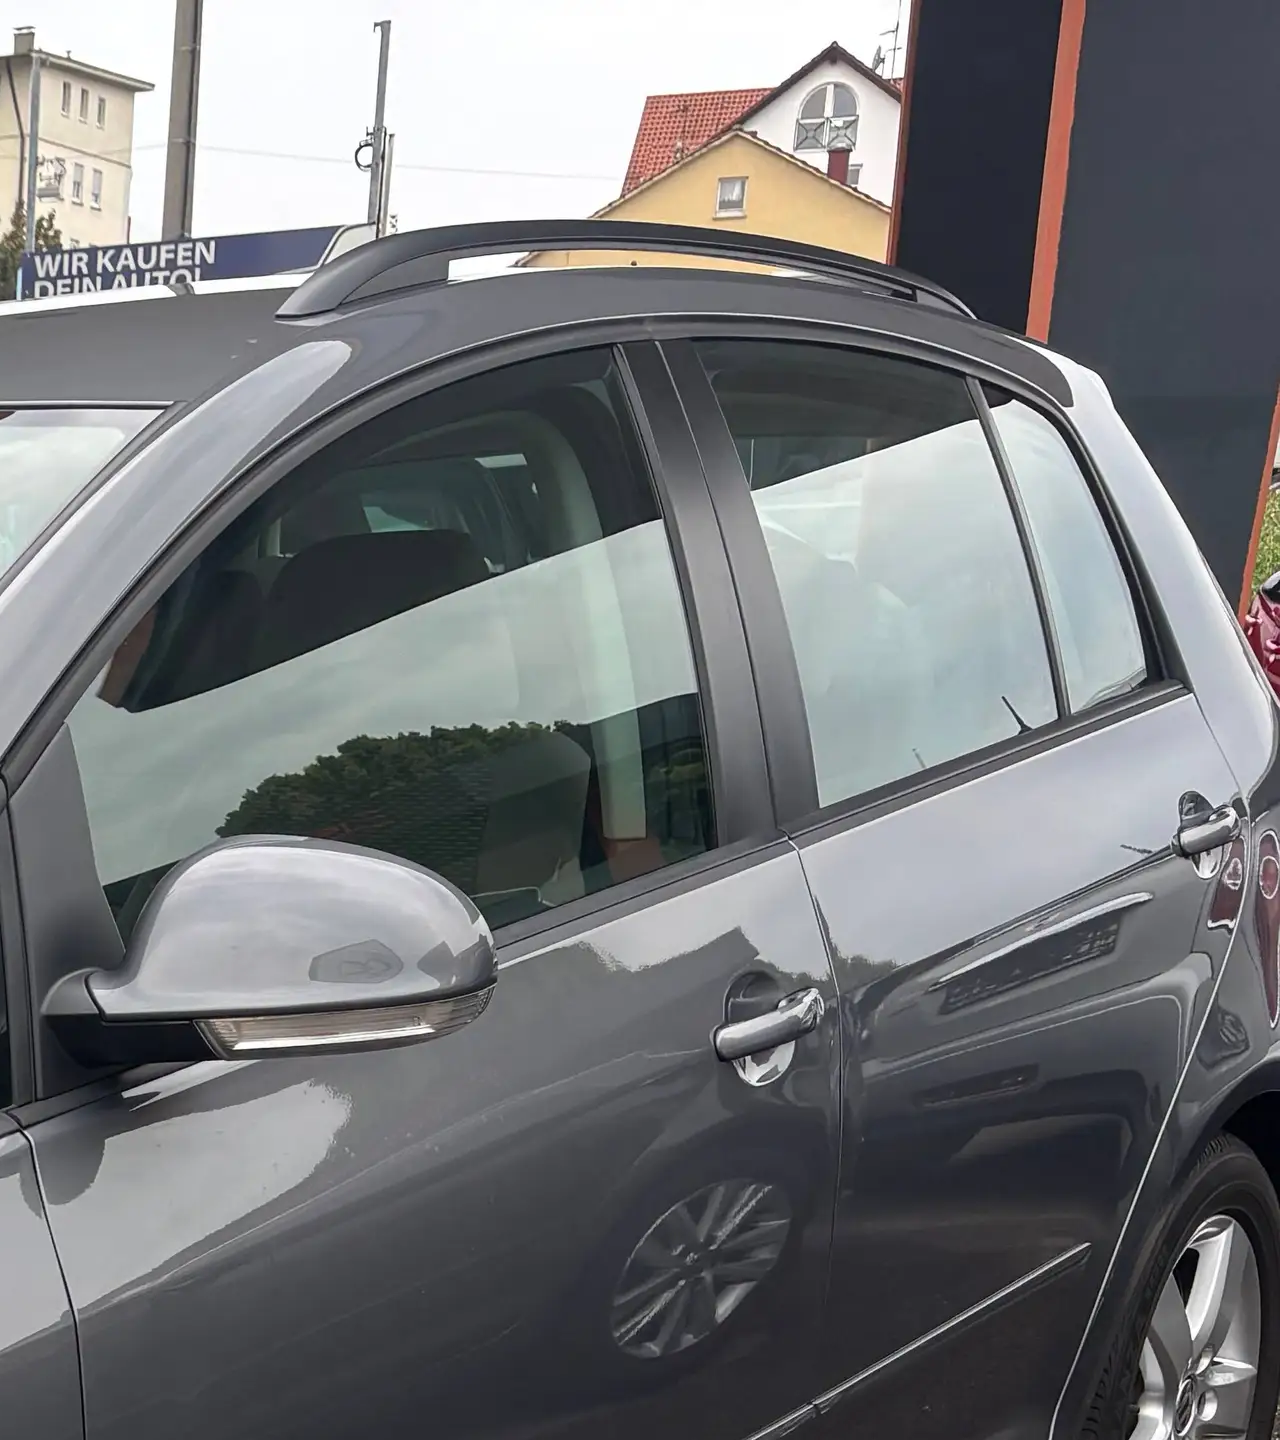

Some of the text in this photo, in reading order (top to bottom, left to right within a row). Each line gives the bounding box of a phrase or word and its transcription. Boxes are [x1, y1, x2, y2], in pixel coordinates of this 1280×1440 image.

[33, 240, 215, 278] WIR KAUFEN
[34, 276, 102, 299] DEIN
